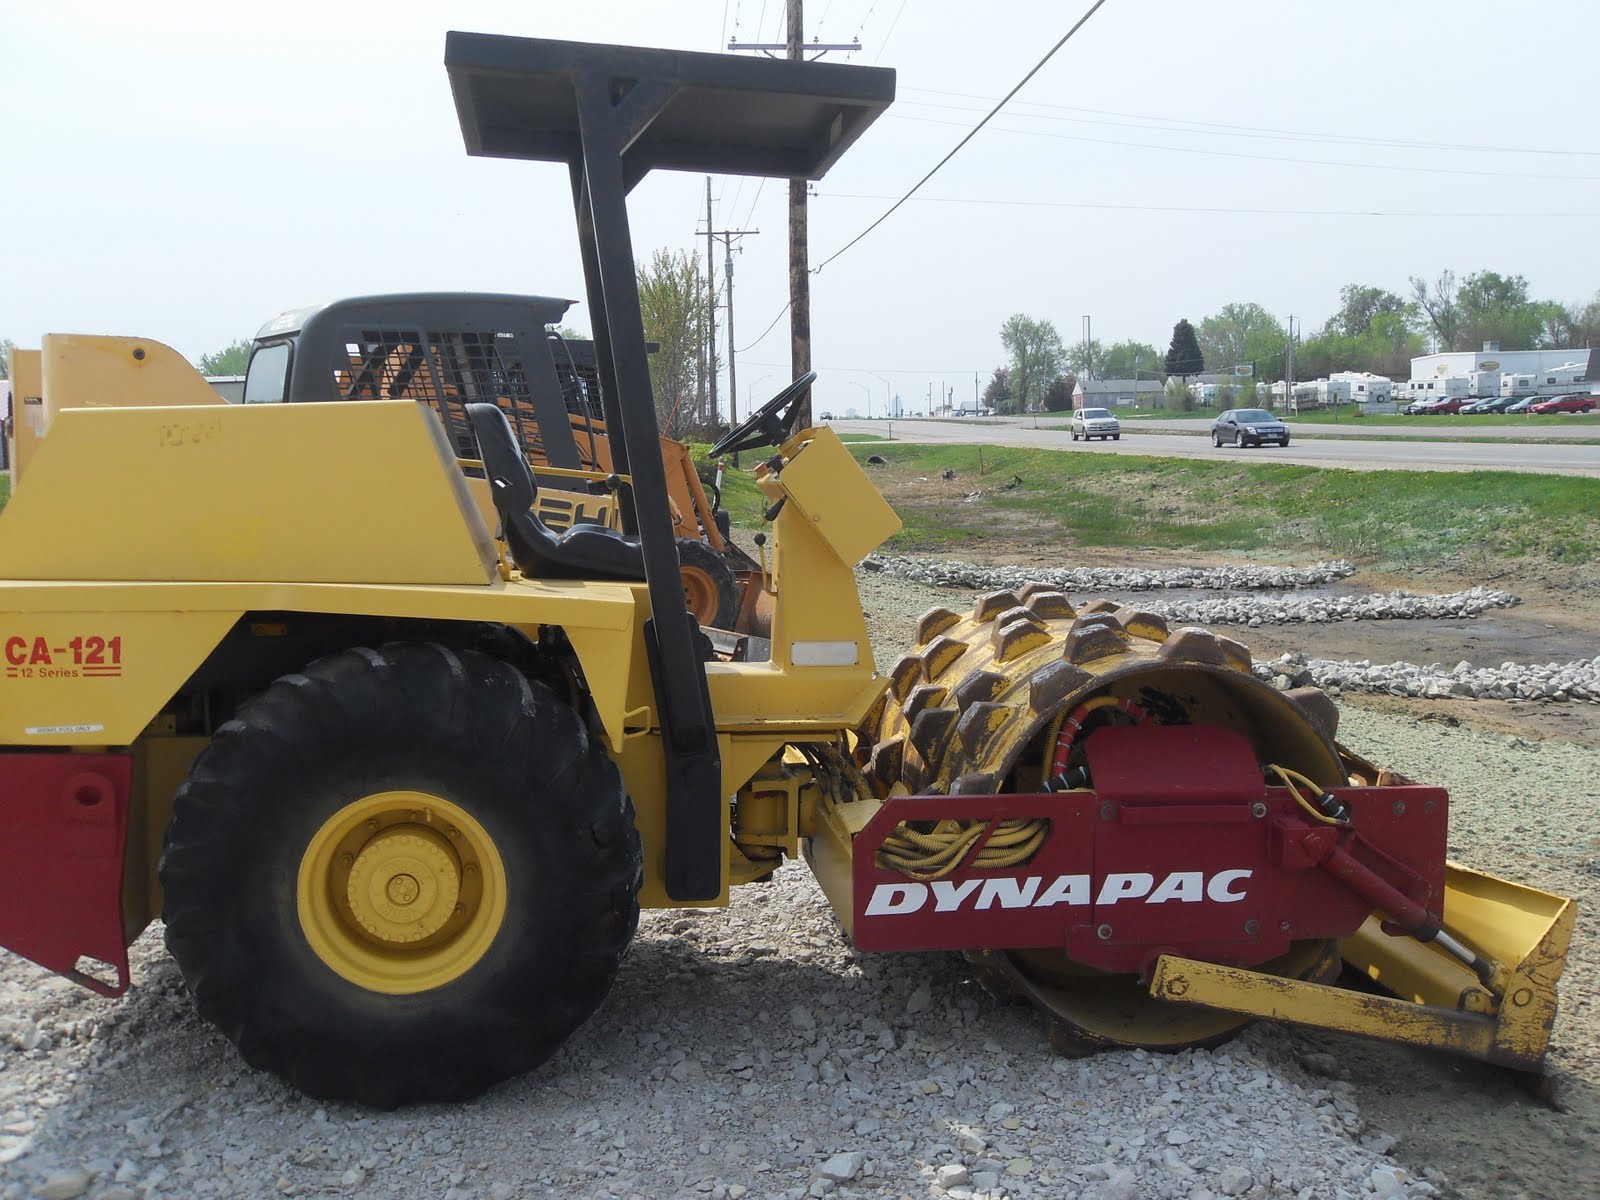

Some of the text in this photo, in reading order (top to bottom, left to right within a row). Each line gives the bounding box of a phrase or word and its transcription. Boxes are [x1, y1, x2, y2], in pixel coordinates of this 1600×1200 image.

[5, 636, 121, 666] CA-121
[21, 667, 79, 678] 12 Series
[864, 869, 1253, 916] DYNAPAC
